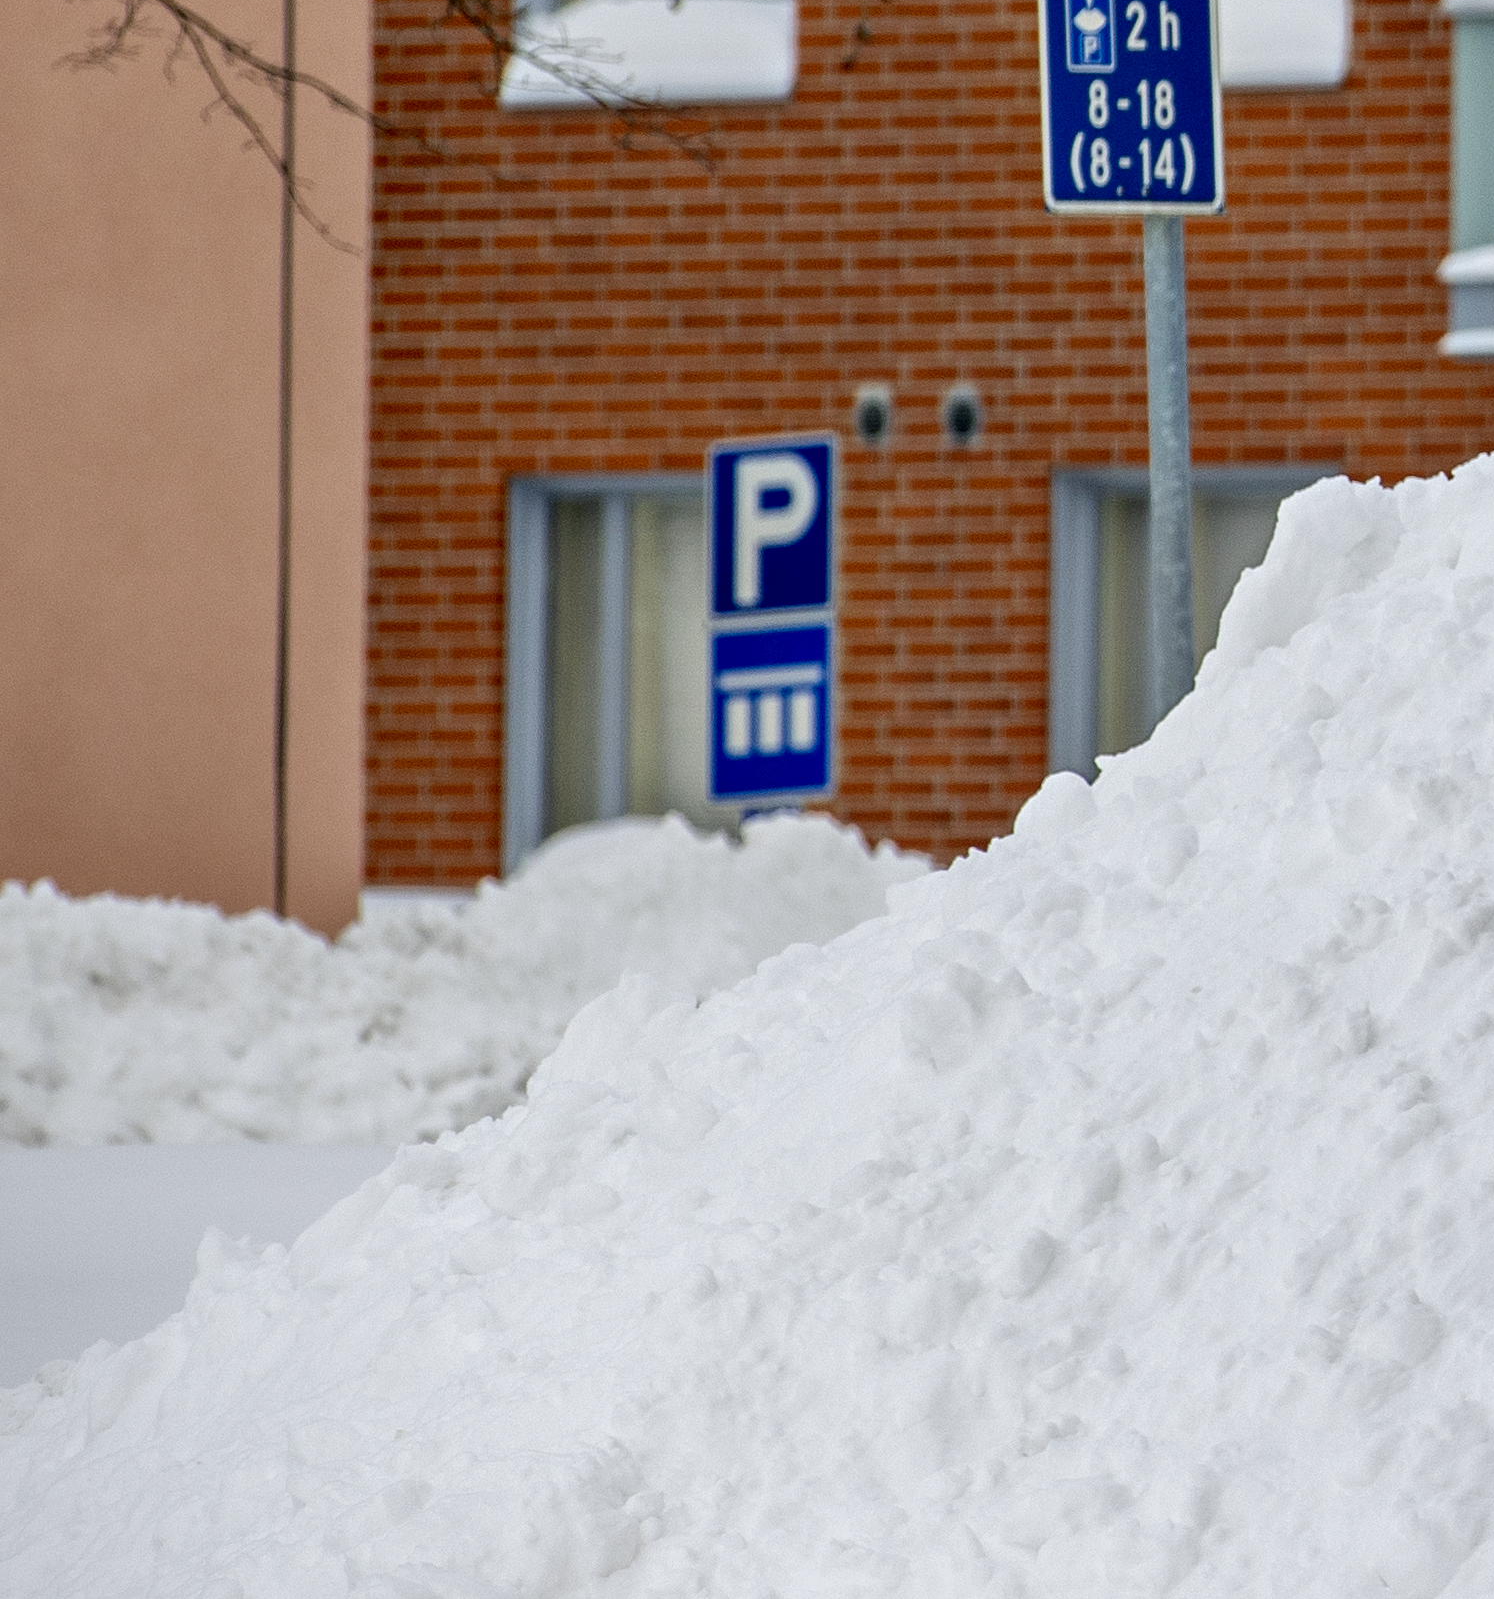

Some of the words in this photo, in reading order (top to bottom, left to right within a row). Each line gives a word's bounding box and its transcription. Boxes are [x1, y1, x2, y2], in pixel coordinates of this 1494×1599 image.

[1125, 0, 1147, 51] 2
[1159, 0, 1181, 50] h
[1088, 79, 1176, 129] 8-18
[1070, 131, 1196, 195] (8-14)
[733, 452, 820, 608] P
